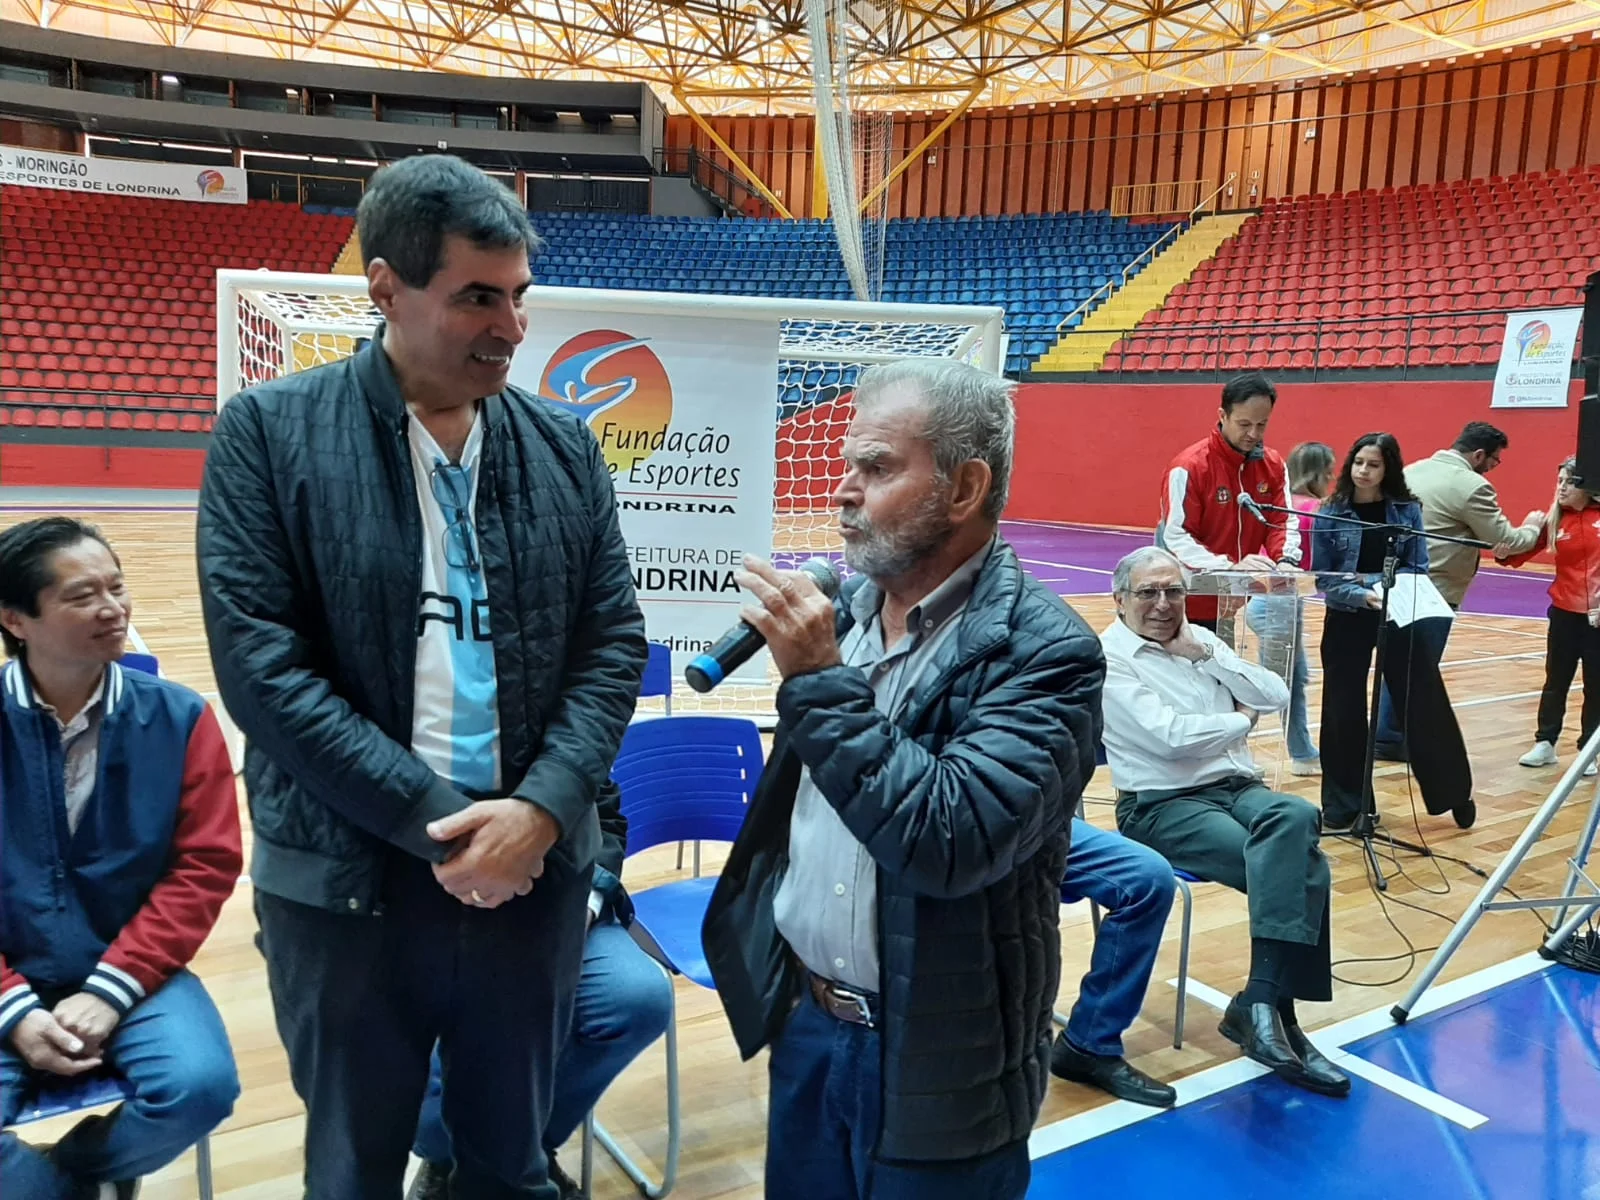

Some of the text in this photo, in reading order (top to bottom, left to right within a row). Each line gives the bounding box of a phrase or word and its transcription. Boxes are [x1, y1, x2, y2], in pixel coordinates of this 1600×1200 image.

[16, 155, 88, 177] MORINGÃO
[82, 180, 102, 191] DE
[107, 182, 181, 196] LONDRINA
[1518, 377, 1561, 385] LONDRINA
[601, 421, 730, 459] Fundação
[629, 456, 741, 491] Esportes
[616, 500, 736, 515] NDRINA
[715, 549, 742, 566] DE
[650, 635, 713, 653] drina
